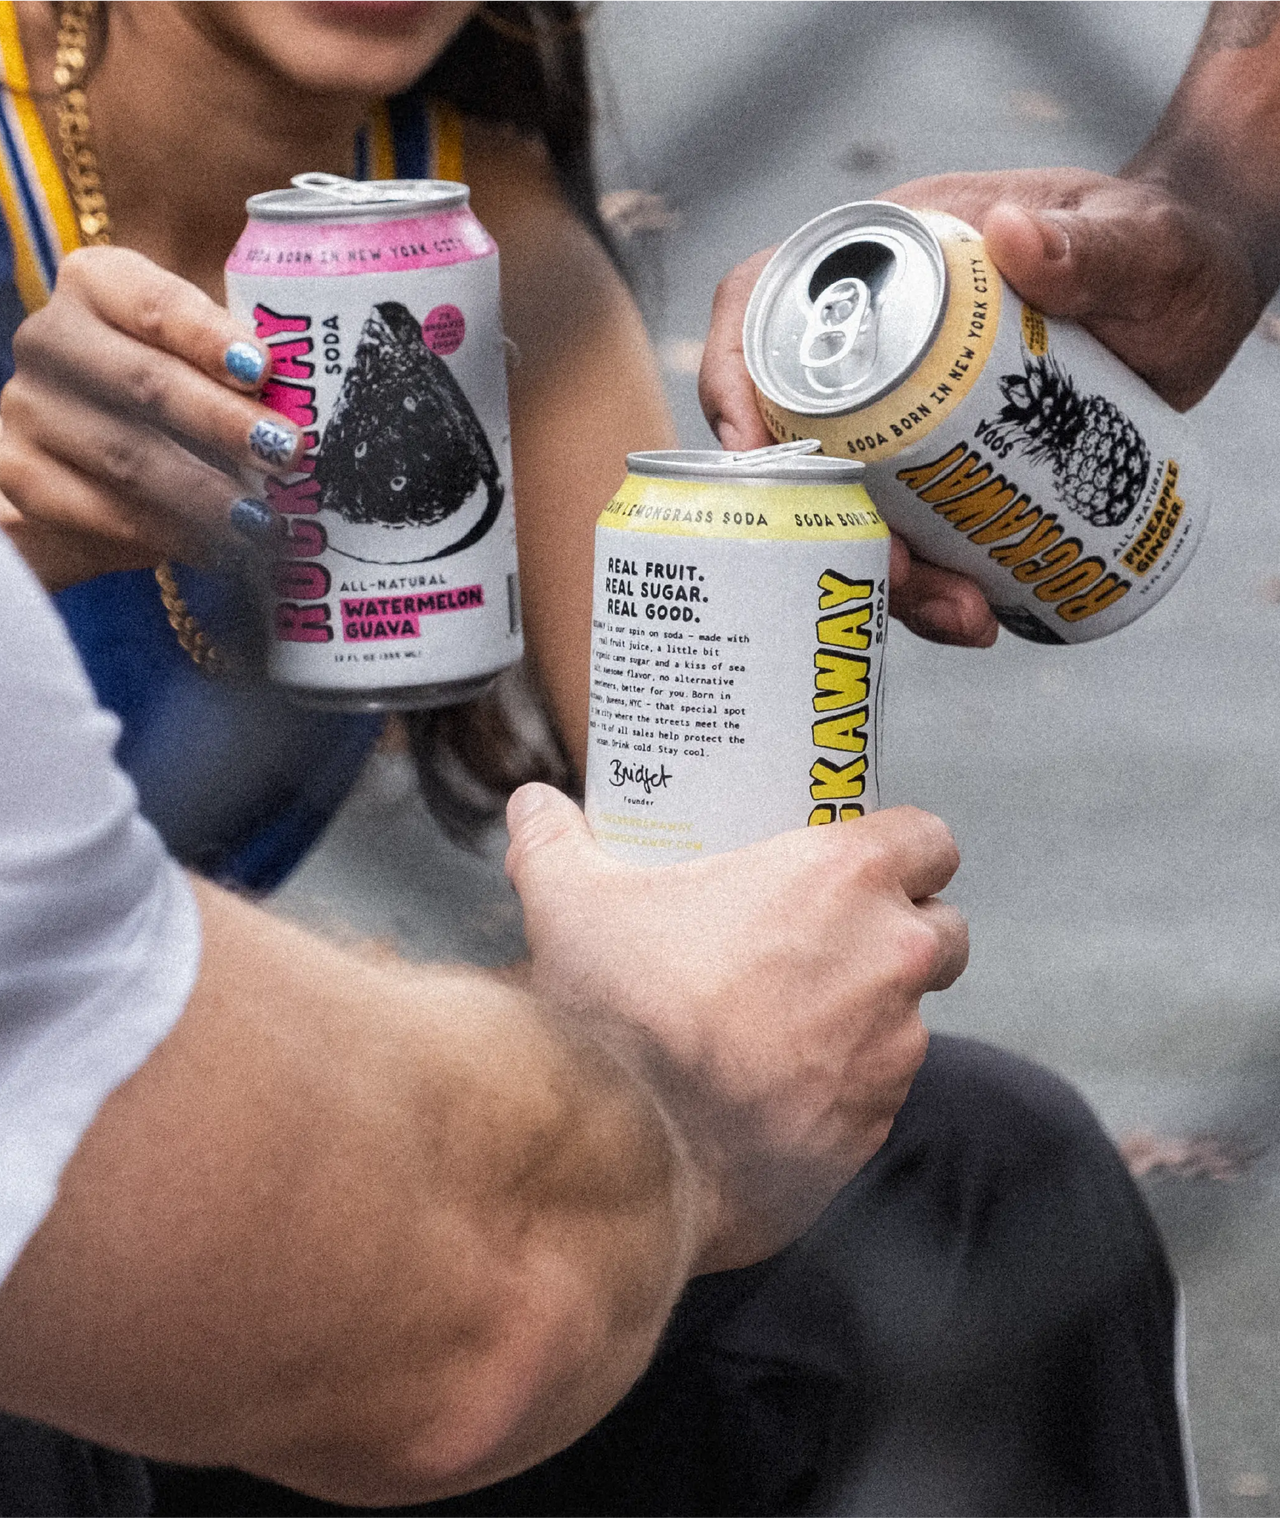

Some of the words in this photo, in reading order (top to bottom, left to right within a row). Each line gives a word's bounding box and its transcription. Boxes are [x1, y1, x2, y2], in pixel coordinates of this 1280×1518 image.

[276, 251, 312, 263] BORN
[348, 250, 381, 262] NEW
[392, 245, 428, 259] YORK
[970, 258, 988, 293] CITY
[968, 301, 988, 338] YORK
[323, 315, 342, 374] SODA
[949, 346, 976, 381] NEW
[930, 382, 953, 404] IN
[889, 404, 932, 437] BORN
[846, 432, 889, 453] SODA
[974, 419, 1015, 459] SODA
[253, 303, 333, 643] ROCKWAY
[722, 511, 768, 526] SODA
[795, 513, 835, 527] SODA
[840, 512, 869, 526] BORN
[1113, 460, 1165, 557] ALL-NATURAL
[1124, 463, 1178, 565] PINEAPPLE
[896, 440, 1132, 622] ROCKAWAY
[1136, 501, 1182, 573] GINGER
[608, 557, 638, 576] REAL
[645, 561, 705, 582] FRUIT.
[340, 574, 447, 592] ALL-NATURAL
[605, 577, 634, 597] REAL
[640, 581, 709, 603] SUGAR.
[344, 587, 482, 617] WATERMELON
[607, 598, 638, 618] REAL
[645, 602, 701, 623] GOOD.
[876, 578, 886, 644] SODA
[345, 620, 416, 639] GUAVA
[629, 627, 645, 636] spin
[664, 629, 683, 640] soda
[699, 633, 721, 642] made
[727, 634, 750, 643] with
[610, 638, 626, 648] fruit
[629, 641, 653, 653] juice,
[667, 645, 698, 656] little
[703, 648, 720, 657] bit
[629, 657, 650, 666] sugar
[655, 660, 670, 668] and
[685, 661, 706, 670] kiss
[711, 663, 723, 671] of
[627, 669, 655, 682] flavor,
[674, 675, 735, 687] alternative
[621, 683, 645, 693] better
[650, 686, 664, 695] for
[669, 690, 689, 698] you.
[692, 690, 714, 699] Born
[720, 692, 731, 700] in
[629, 699, 642, 708] NYC
[655, 702, 675, 711] that
[680, 706, 717, 714] special
[723, 707, 746, 716] spot
[614, 711, 633, 721] where
[637, 715, 650, 723] the
[655, 717, 690, 727] streets
[695, 720, 717, 729] meet
[724, 721, 740, 729] the
[617, 726, 628, 735] all
[632, 728, 654, 738] sales
[658, 731, 680, 741] help
[684, 733, 722, 743] protect
[729, 735, 745, 744] the
[611, 739, 630, 749] Drink
[633, 743, 655, 753] cold.
[658, 744, 678, 756] Stay
[683, 748, 710, 758] cool.
